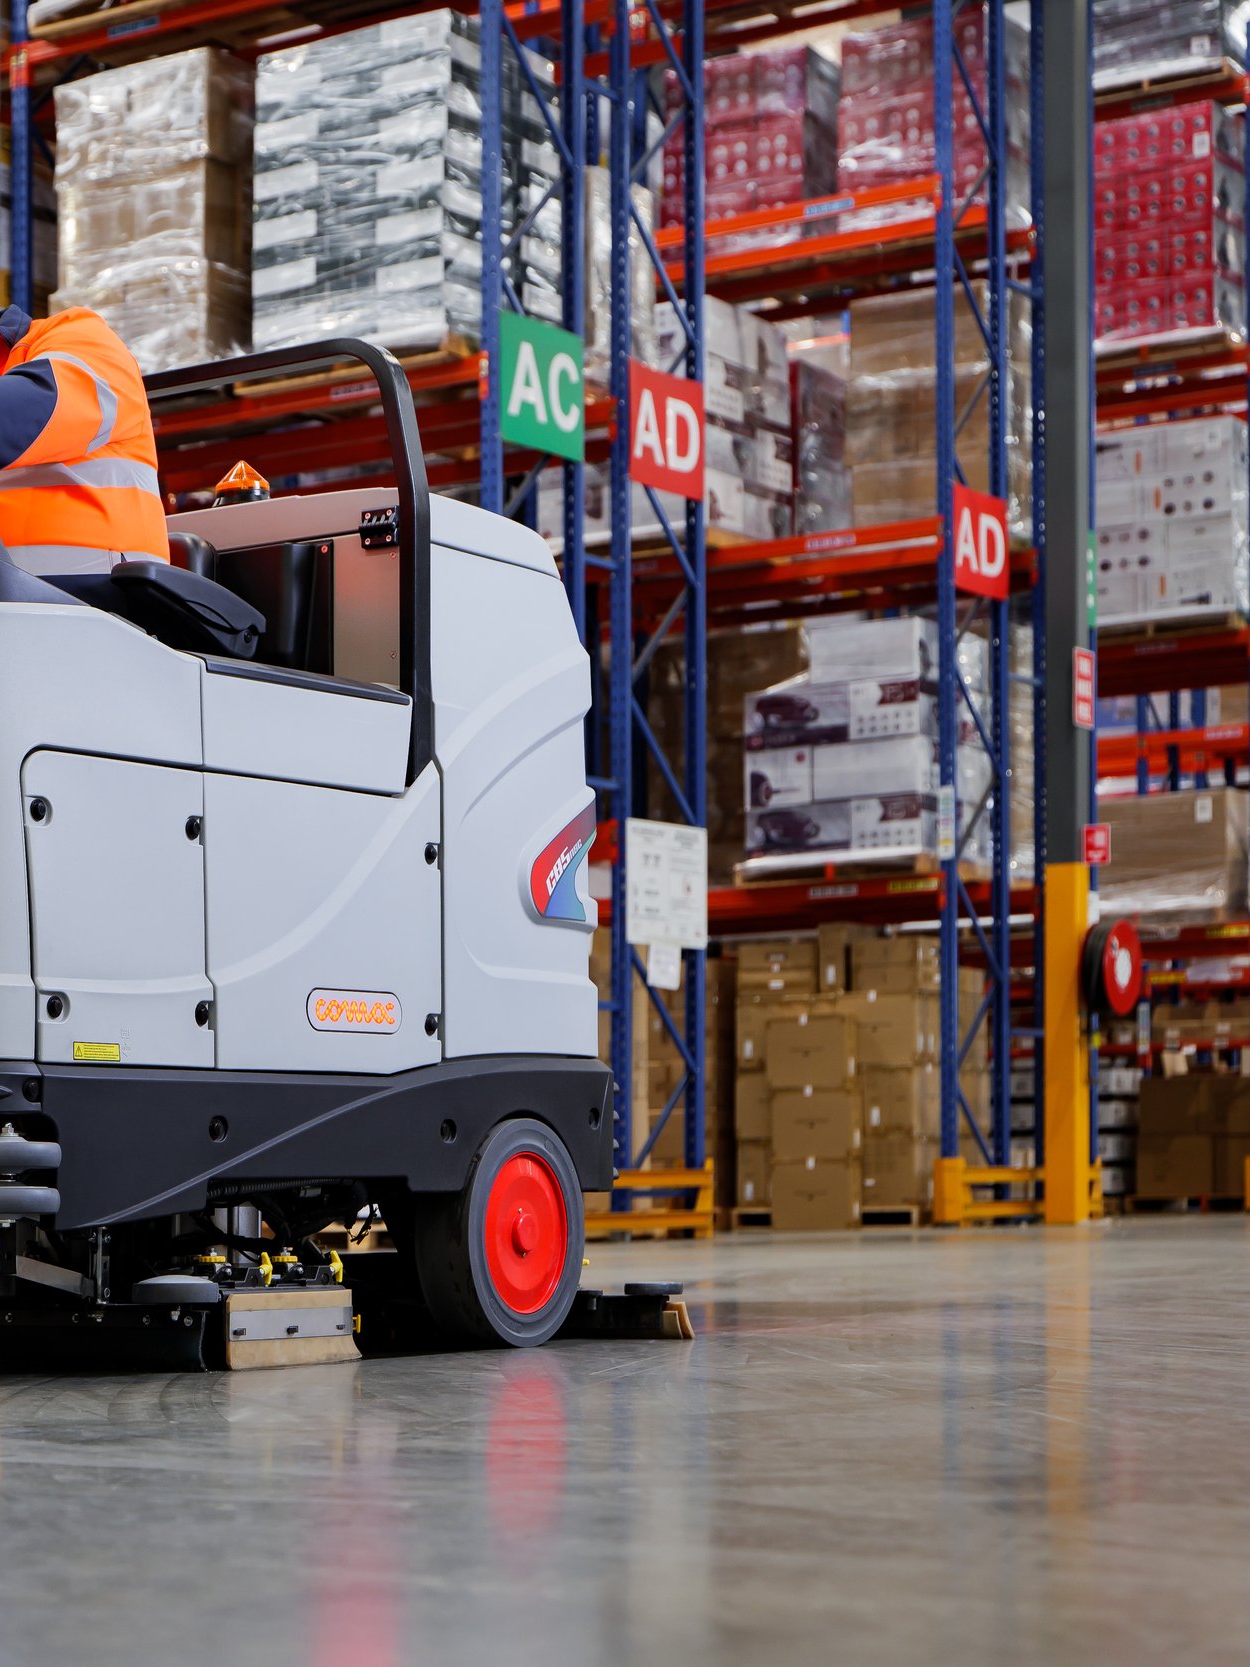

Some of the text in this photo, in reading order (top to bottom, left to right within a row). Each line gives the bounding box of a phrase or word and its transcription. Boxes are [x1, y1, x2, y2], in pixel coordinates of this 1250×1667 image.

[507, 341, 580, 433] AC
[634, 388, 700, 473] AD
[956, 506, 1006, 578] AD
